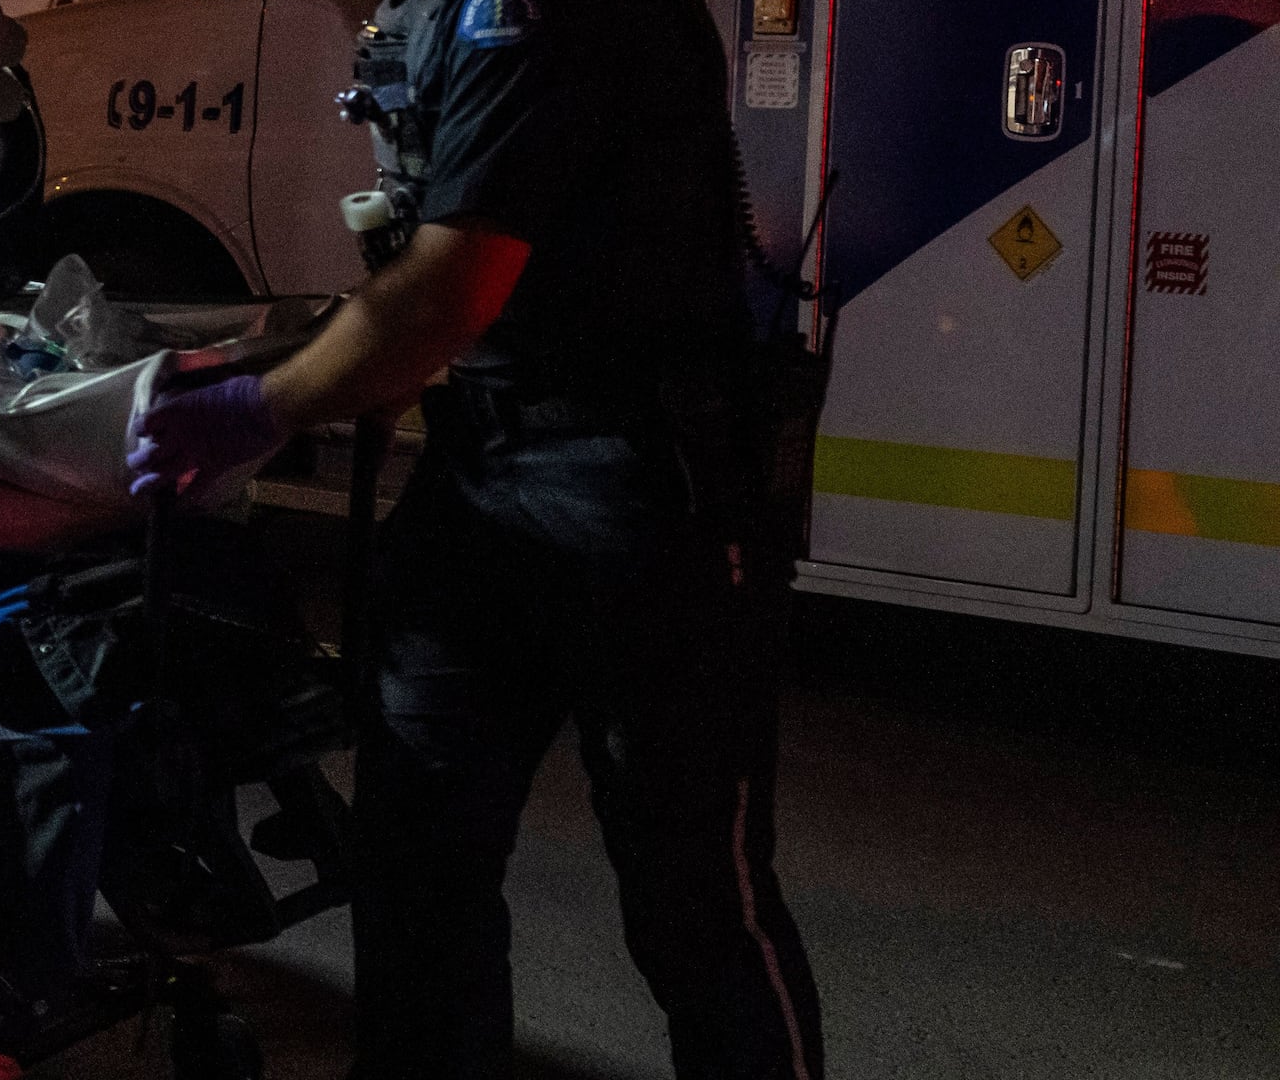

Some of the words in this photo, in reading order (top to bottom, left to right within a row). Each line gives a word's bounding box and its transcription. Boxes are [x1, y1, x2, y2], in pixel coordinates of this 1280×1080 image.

[127, 80, 244, 134] 9-1-1
[1160, 243, 1195, 256] FIRE
[1156, 270, 1196, 282] INSIDE
